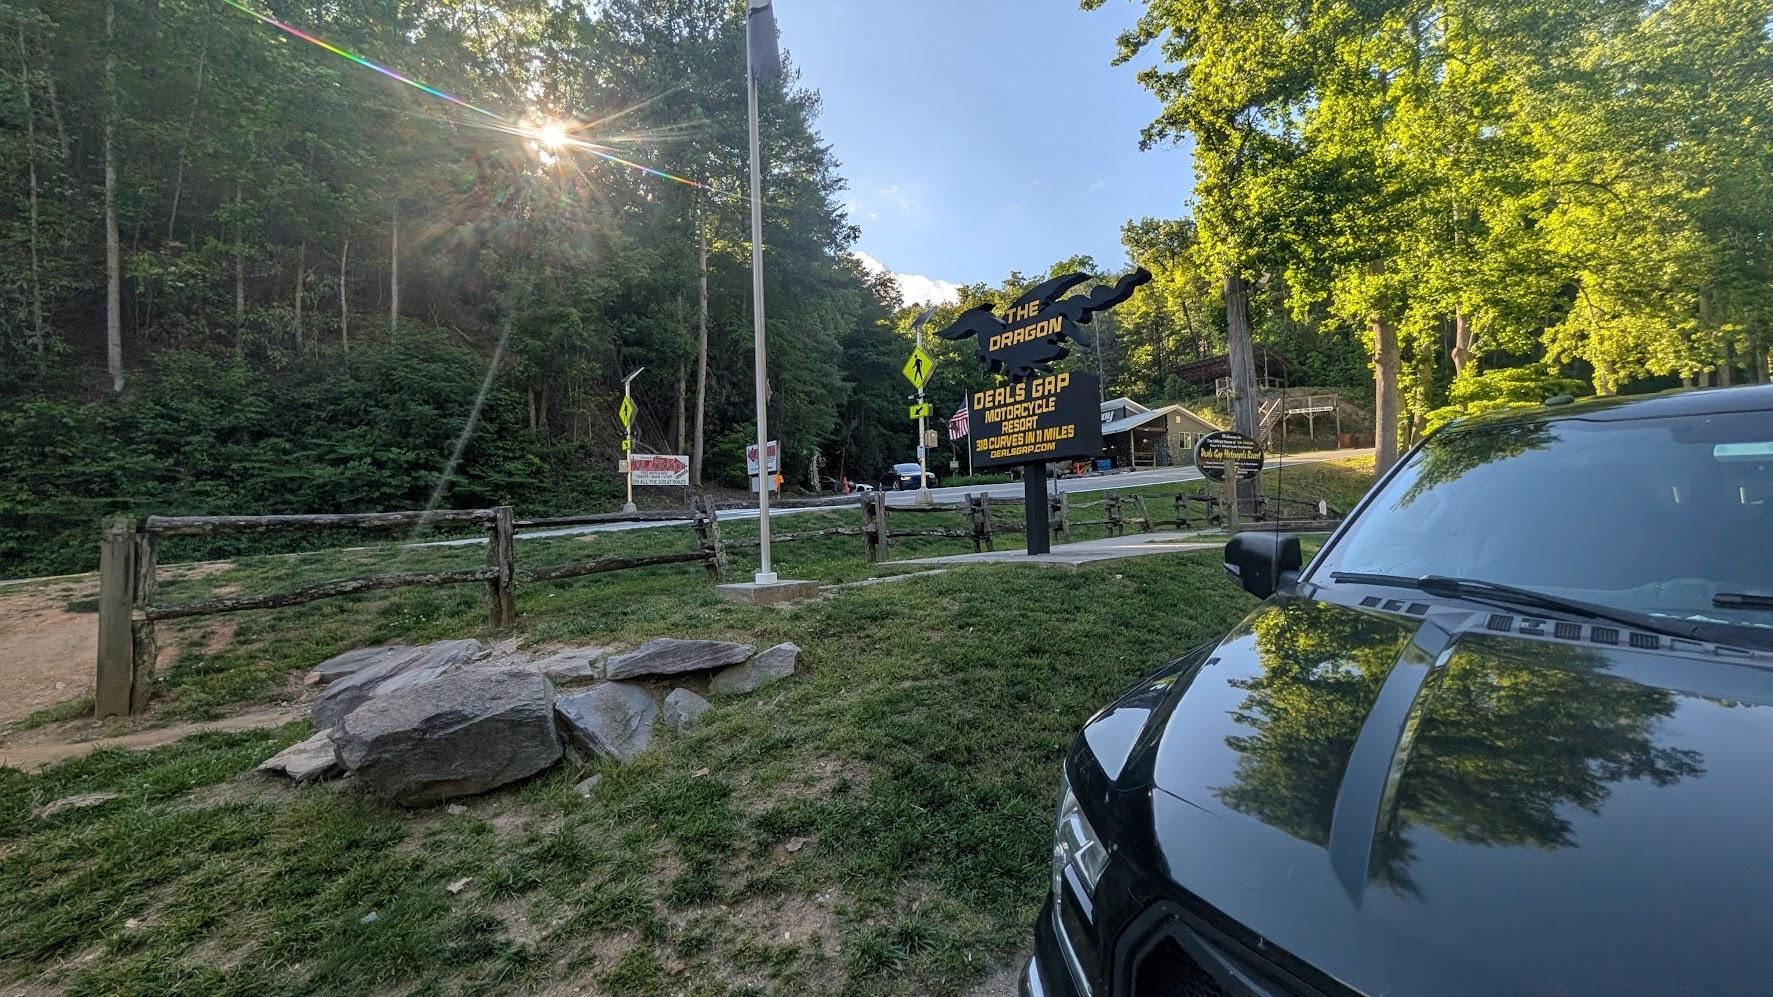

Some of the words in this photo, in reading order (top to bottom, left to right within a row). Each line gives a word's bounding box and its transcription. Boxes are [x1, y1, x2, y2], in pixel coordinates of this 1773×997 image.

[1006, 300, 1040, 324] THE
[989, 316, 1062, 352] DRAGON
[973, 382, 1026, 410] DEALS
[1031, 372, 1070, 399] GAP
[985, 396, 1056, 424] MOTORCYCLE
[975, 438, 989, 452] 318
[988, 432, 1025, 450] CURVES
[1025, 430, 1036, 445] IN
[1036, 429, 1043, 443] 11
[1043, 424, 1075, 442] MILES
[1001, 416, 1039, 435] RESORT
[990, 442, 1057, 459] DEALSGAP.COM
[1213, 448, 1223, 461] Gap
